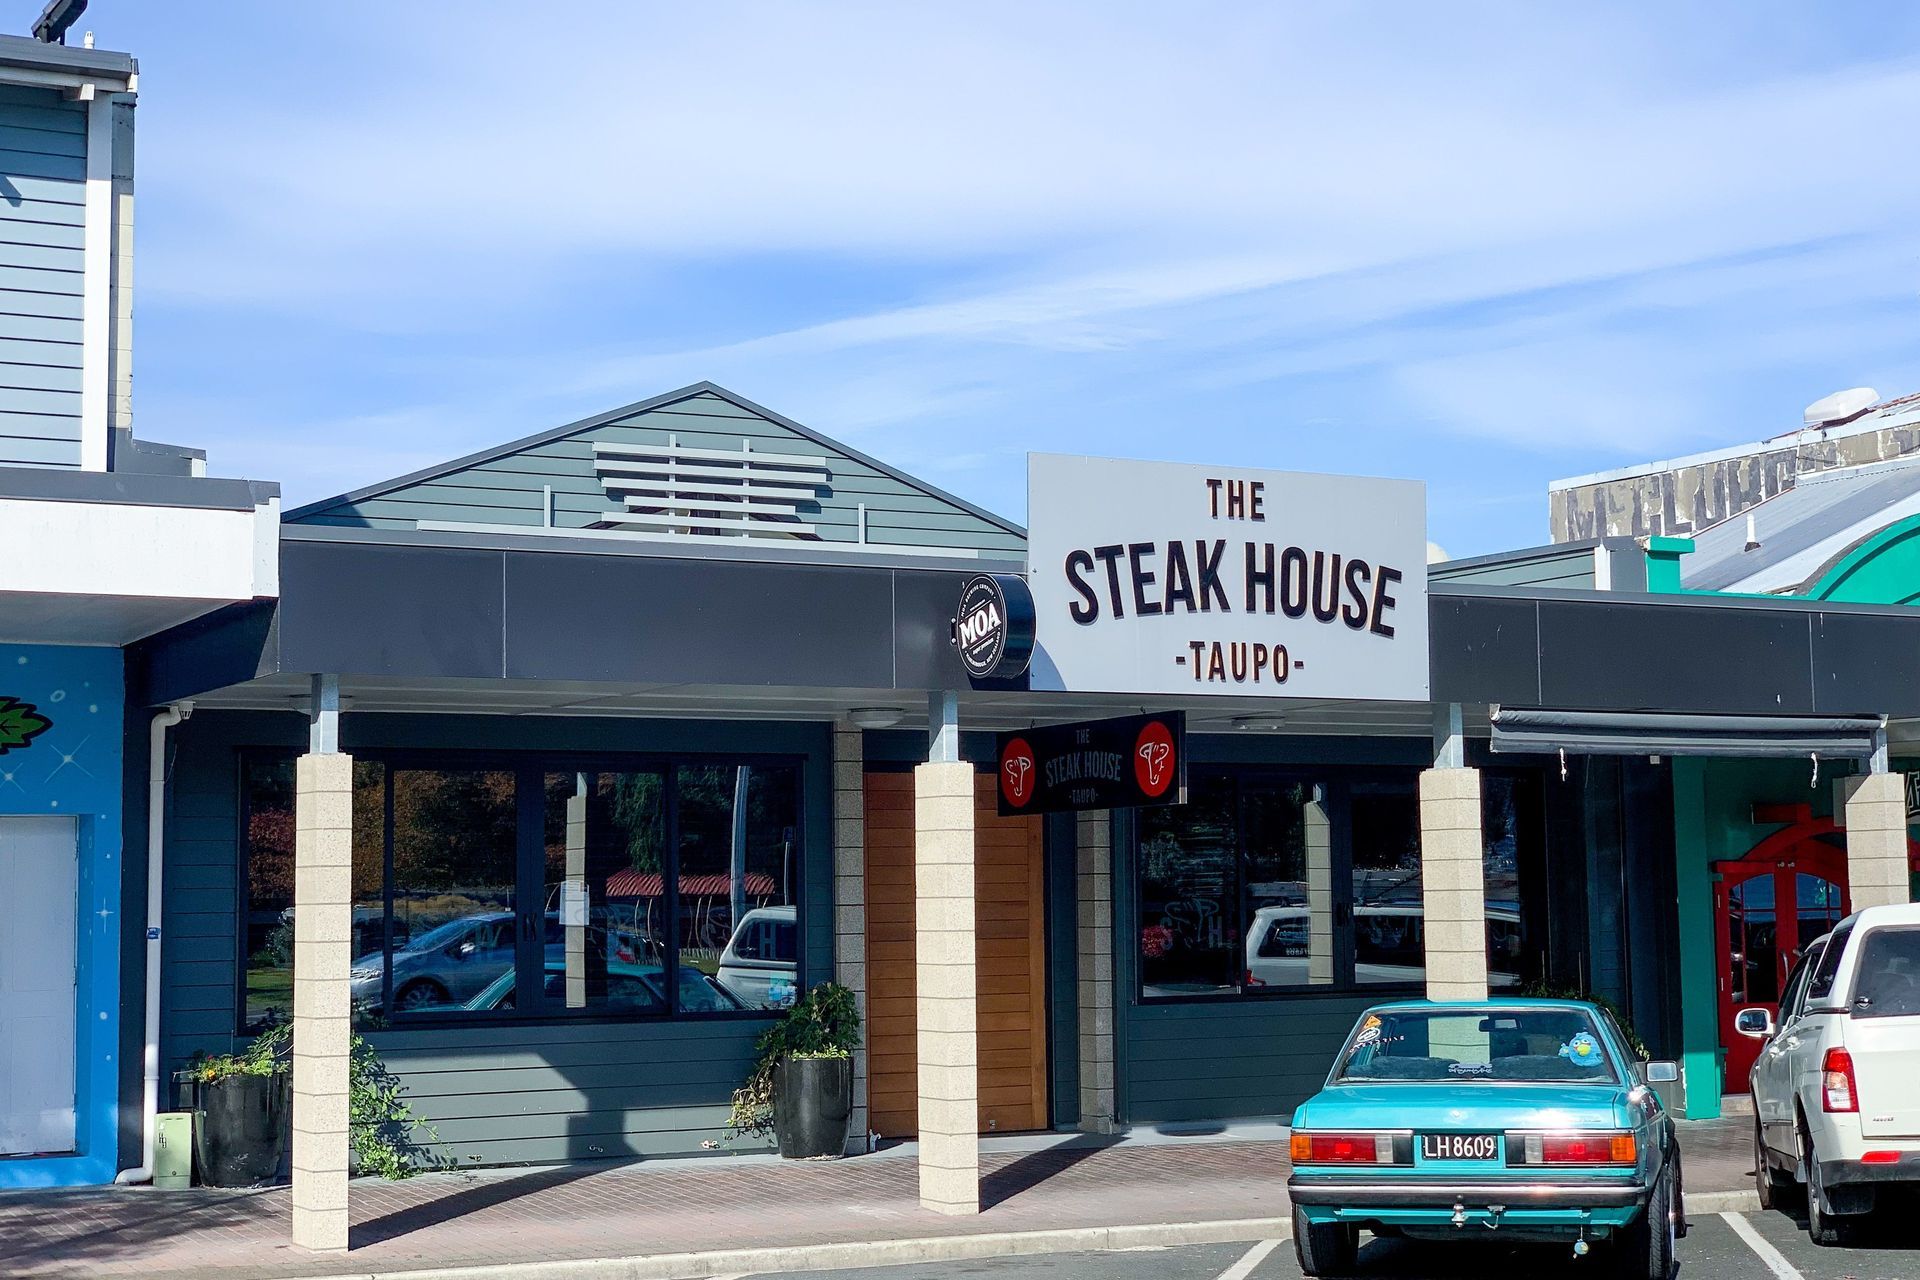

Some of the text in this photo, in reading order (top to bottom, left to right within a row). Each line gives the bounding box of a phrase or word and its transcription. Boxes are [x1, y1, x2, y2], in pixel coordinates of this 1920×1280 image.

[1207, 478, 1266, 521] THE
[1064, 539, 1402, 639] STEAK HOUSE
[959, 602, 1002, 650] MOA
[1176, 640, 1305, 683] -TAUPO-
[1075, 729, 1091, 744] THE
[1045, 749, 1123, 788] STEAK HOUSE
[1424, 1136, 1495, 1158] LH8609
